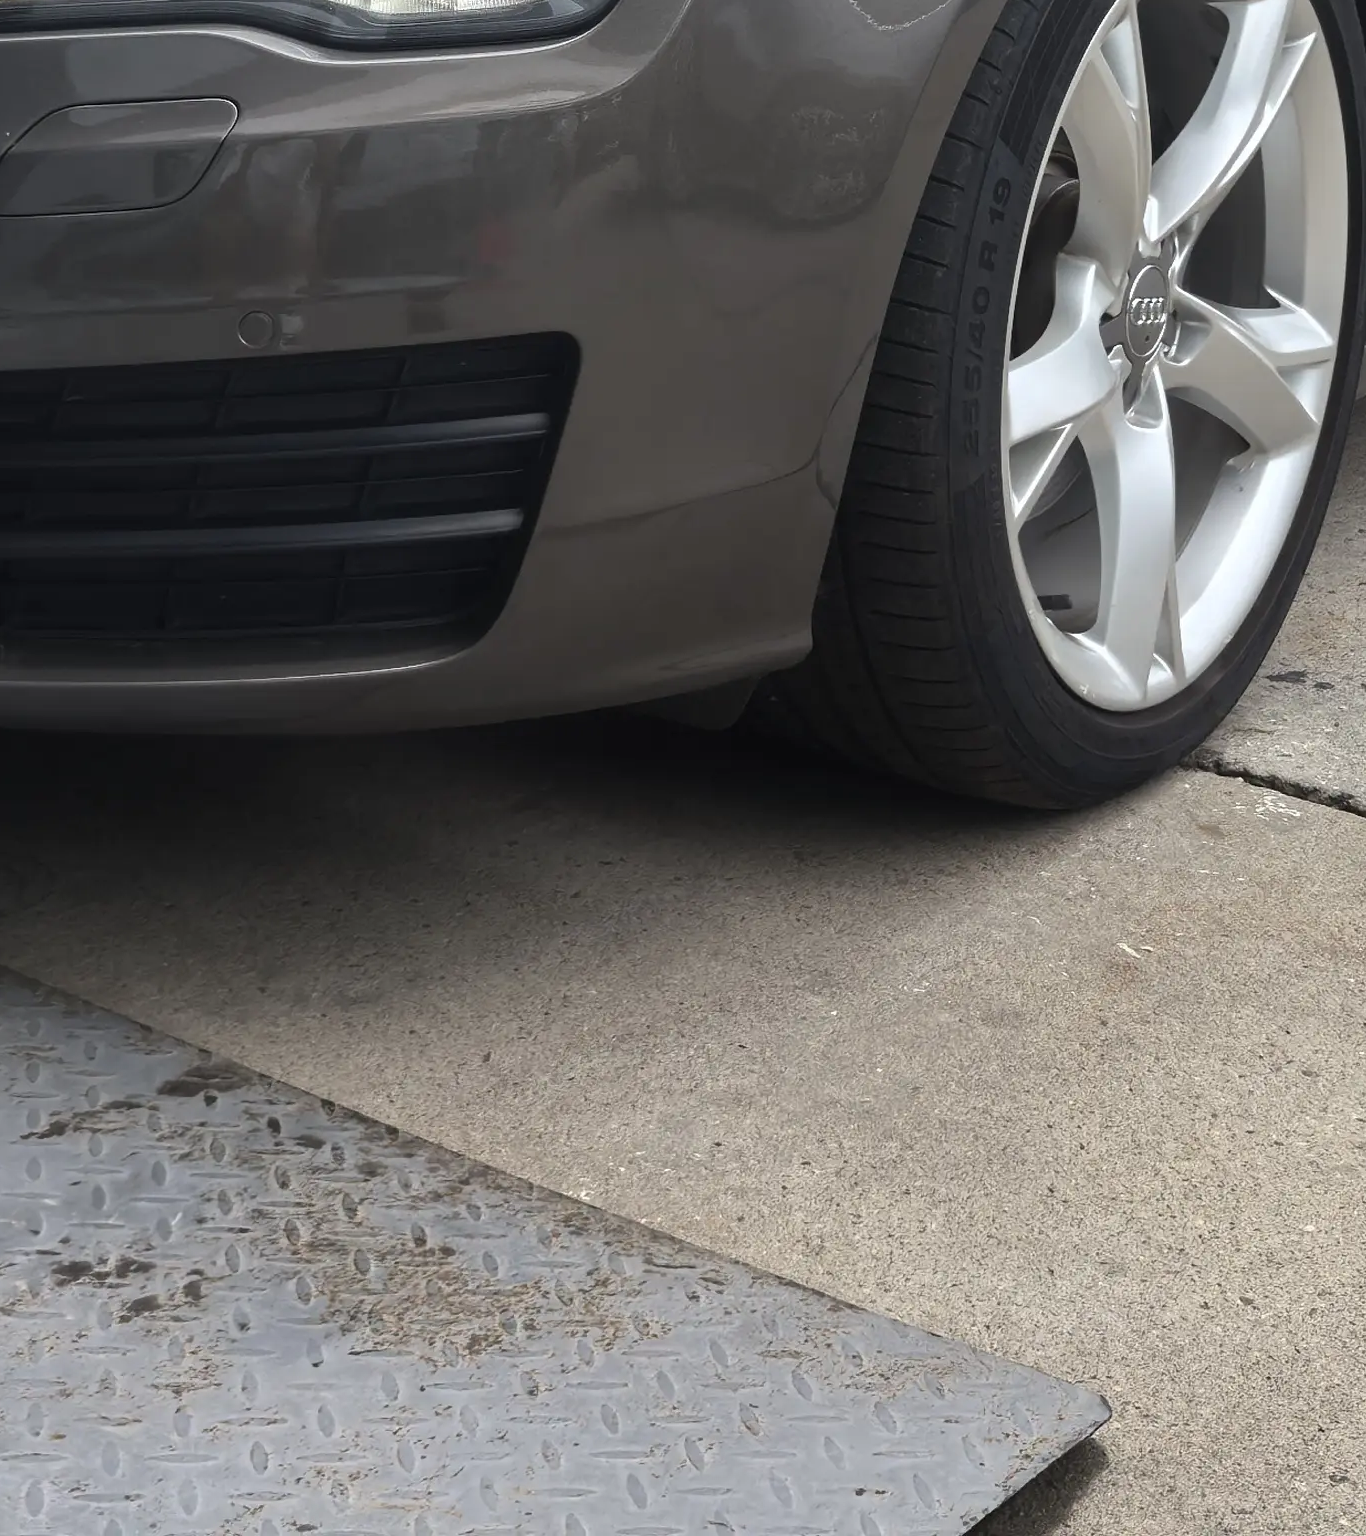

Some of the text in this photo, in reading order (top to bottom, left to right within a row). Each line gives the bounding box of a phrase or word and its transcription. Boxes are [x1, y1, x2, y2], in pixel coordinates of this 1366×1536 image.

[961, 177, 1012, 457] 255/40 R 19
